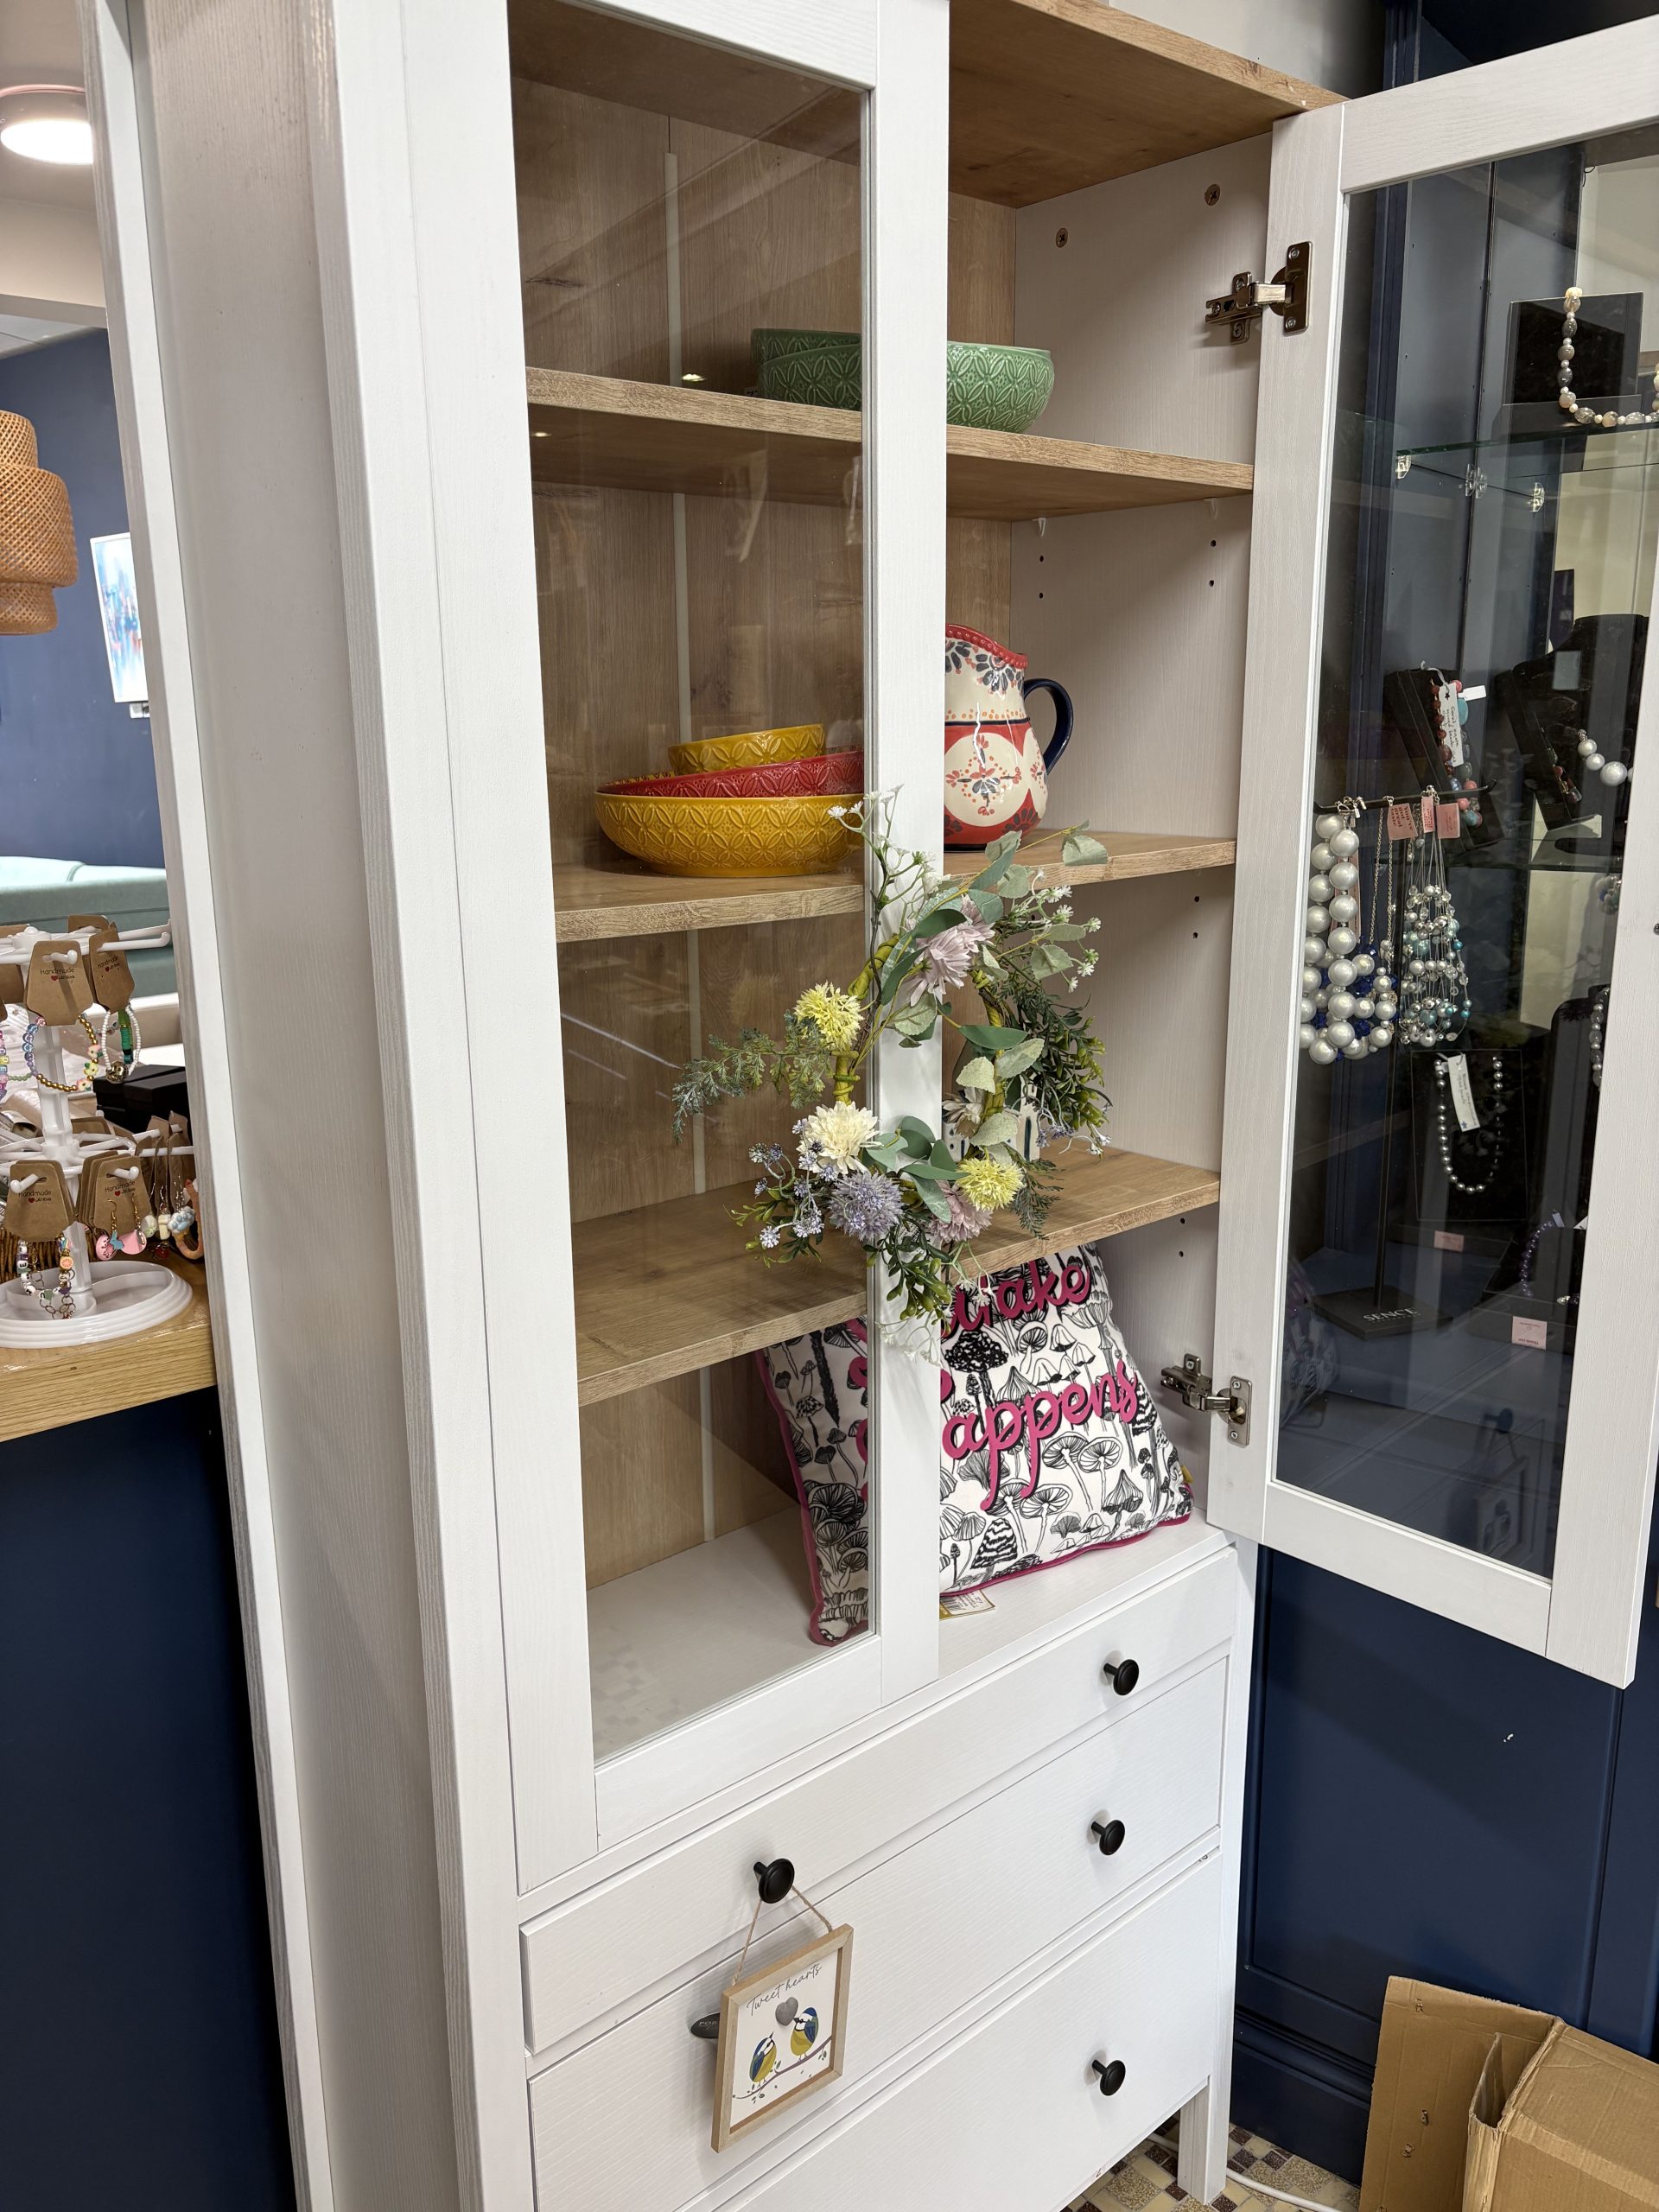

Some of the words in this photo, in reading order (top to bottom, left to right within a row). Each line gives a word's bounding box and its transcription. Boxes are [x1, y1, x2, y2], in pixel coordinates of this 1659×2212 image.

[18, 1189, 52, 1198] Handmade
[105, 1180, 136, 1193] Handmade
[941, 1358, 1138, 1510] appens
[746, 1982, 785, 2017] Tweet
[785, 1962, 823, 1991] hearts
